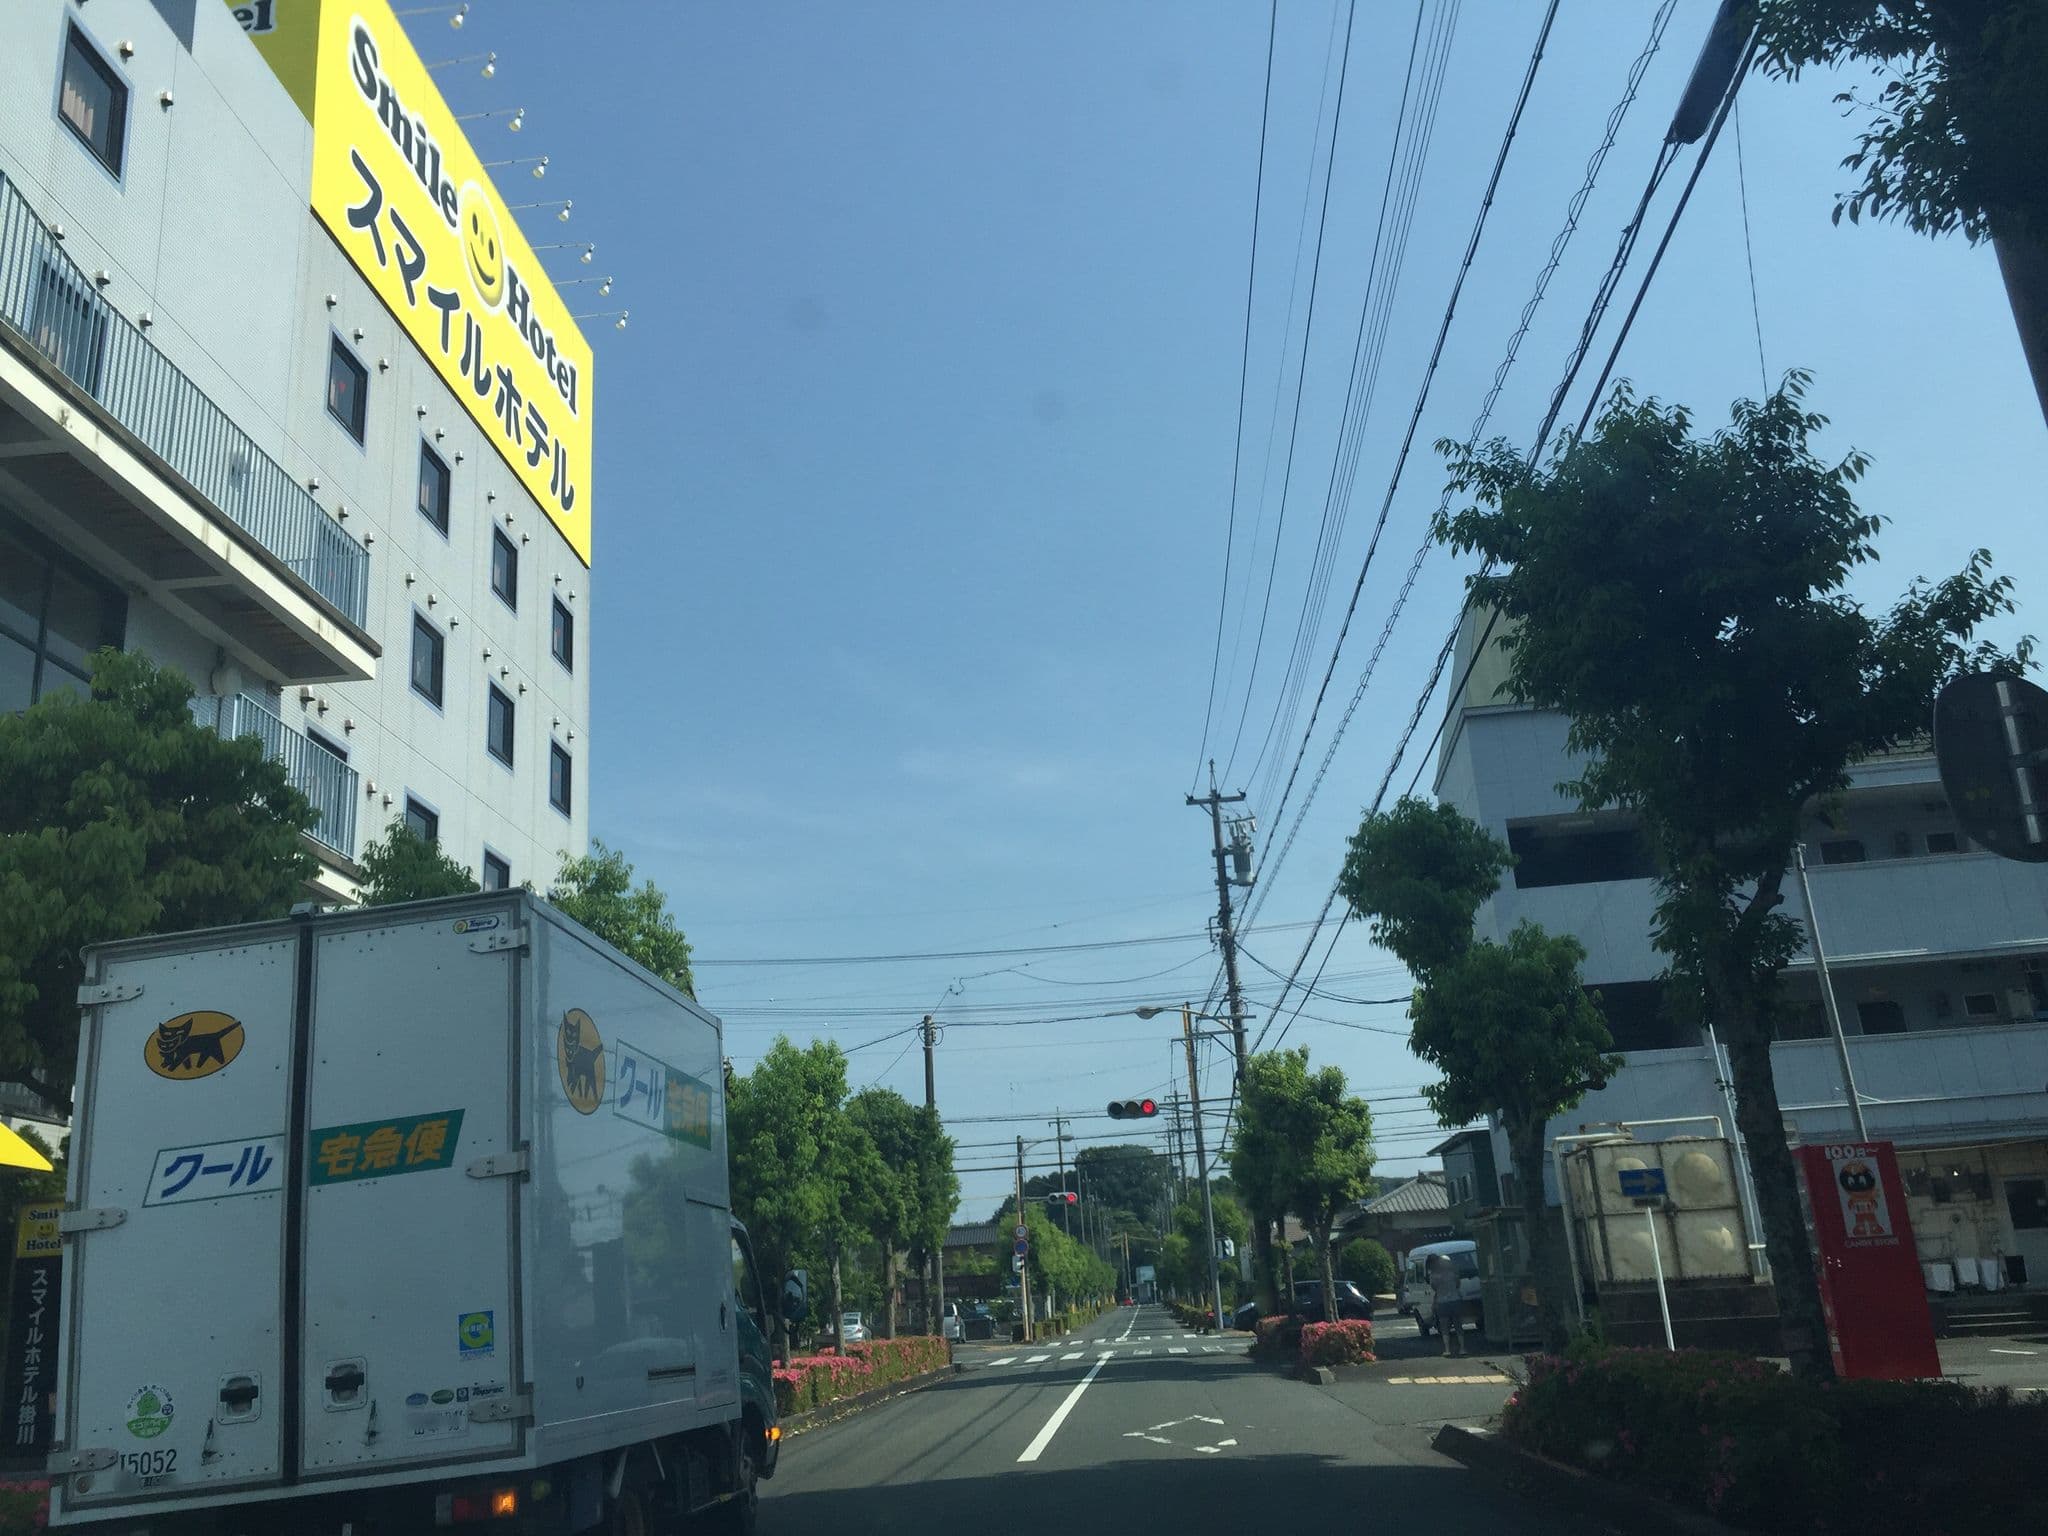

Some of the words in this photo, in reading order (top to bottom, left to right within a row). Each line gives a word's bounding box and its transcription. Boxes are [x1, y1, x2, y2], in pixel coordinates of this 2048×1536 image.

[353, 24, 458, 228] Smile
[507, 265, 578, 415] Hotel
[347, 149, 575, 511] スマイルホテル
[620, 1055, 663, 1121] クール
[161, 1145, 274, 1199] クール
[317, 1119, 449, 1176] 宅急便
[26, 1239, 63, 1250] Hotel
[29, 1209, 60, 1220] Smil
[16, 1269, 49, 1444] スマイルホテル掛川
